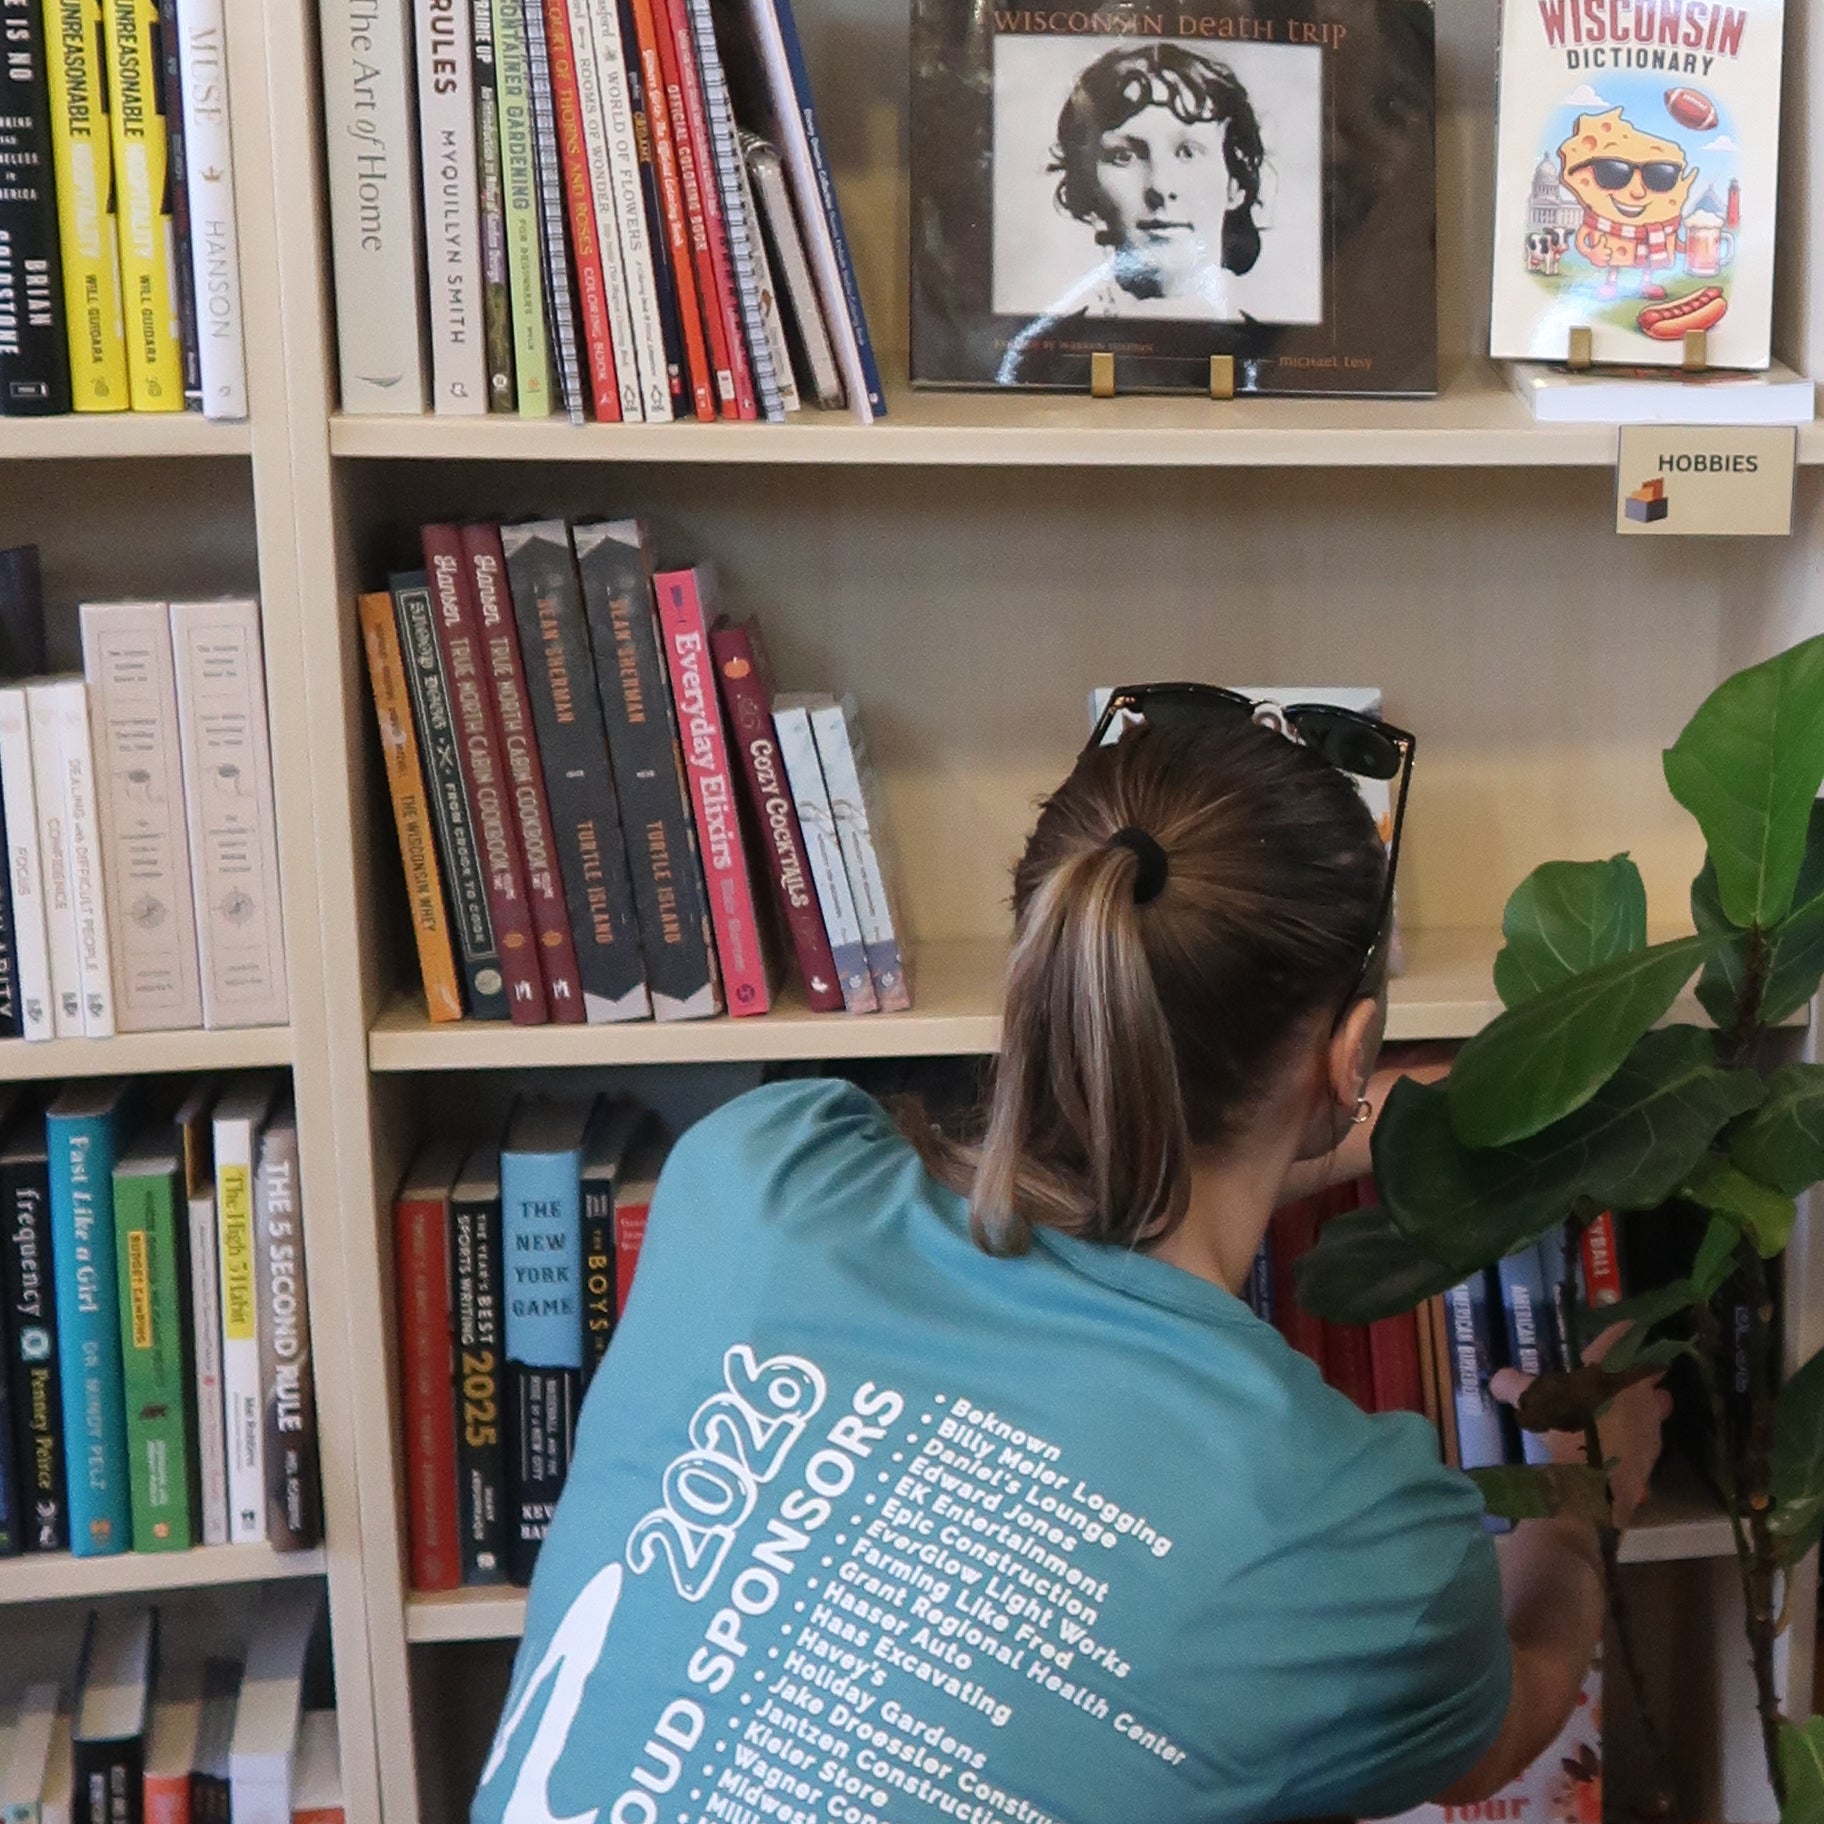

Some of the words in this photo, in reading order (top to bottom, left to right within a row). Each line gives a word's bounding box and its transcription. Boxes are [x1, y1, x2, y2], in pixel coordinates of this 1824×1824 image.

[352, 59, 381, 112] Art
[1565, 45, 1715, 76] DICTIONARY
[347, 119, 383, 147] of
[357, 154, 388, 252] Home
[439, 130, 465, 264] MYQUILLYN
[447, 275, 468, 345] SMITH
[1657, 452, 1759, 475] HOBBIES
[673, 632, 719, 770] Everyday
[700, 775, 735, 870] Elixirs
[266, 1161, 291, 1212] THE
[269, 1222, 293, 1236] 5
[519, 1202, 562, 1219] THE
[13, 1189, 41, 1316] frequency
[514, 1267, 571, 1285] YORK
[515, 1233, 567, 1253] NEW
[271, 1245, 297, 1355] SECOND
[512, 1299, 576, 1317] GAME
[276, 1363, 301, 1430] RULE
[462, 1351, 496, 1447] 2025
[950, 1398, 1062, 1468] Beknown
[624, 1342, 828, 1604] 2026
[908, 1455, 1004, 1512] Edward
[1003, 1503, 1078, 1552] Jones
[922, 1430, 1022, 1495] Daniel's
[1024, 1484, 1117, 1548] Lounge
[937, 1417, 996, 1462] Billy
[997, 1446, 1070, 1490] Meier
[1072, 1480, 1173, 1557] Logging
[688, 1379, 906, 1696] SPONSORS
[881, 1497, 935, 1535] Epic
[939, 1525, 1098, 1626] Construction
[894, 1475, 932, 1506] EK
[931, 1493, 1109, 1603] Entertainment
[822, 1580, 910, 1636] Haaser
[910, 1626, 972, 1670] Auto
[851, 1537, 951, 1603] Farming
[955, 1588, 1010, 1632] Like
[1014, 1623, 1075, 1670] Fred
[866, 1519, 983, 1585] EverGlow
[984, 1575, 1054, 1629] Light
[1059, 1617, 1131, 1678] Works
[796, 1626, 888, 1686] Havey's
[810, 1603, 870, 1647] Haas
[872, 1635, 1012, 1727] Excavating
[839, 1561, 908, 1607] Grant
[909, 1595, 1025, 1670] Regional
[1026, 1659, 1109, 1719] Health
[1113, 1712, 1186, 1765] Center
[755, 1698, 850, 1760] Jantzen
[768, 1675, 825, 1715] Jake
[828, 1703, 953, 1779] Droessler
[783, 1649, 877, 1714] Holiday
[880, 1700, 987, 1769] Gardens
[734, 1743, 823, 1805] Wagner
[743, 1719, 817, 1770] Kieler
[818, 1760, 889, 1807] Store
